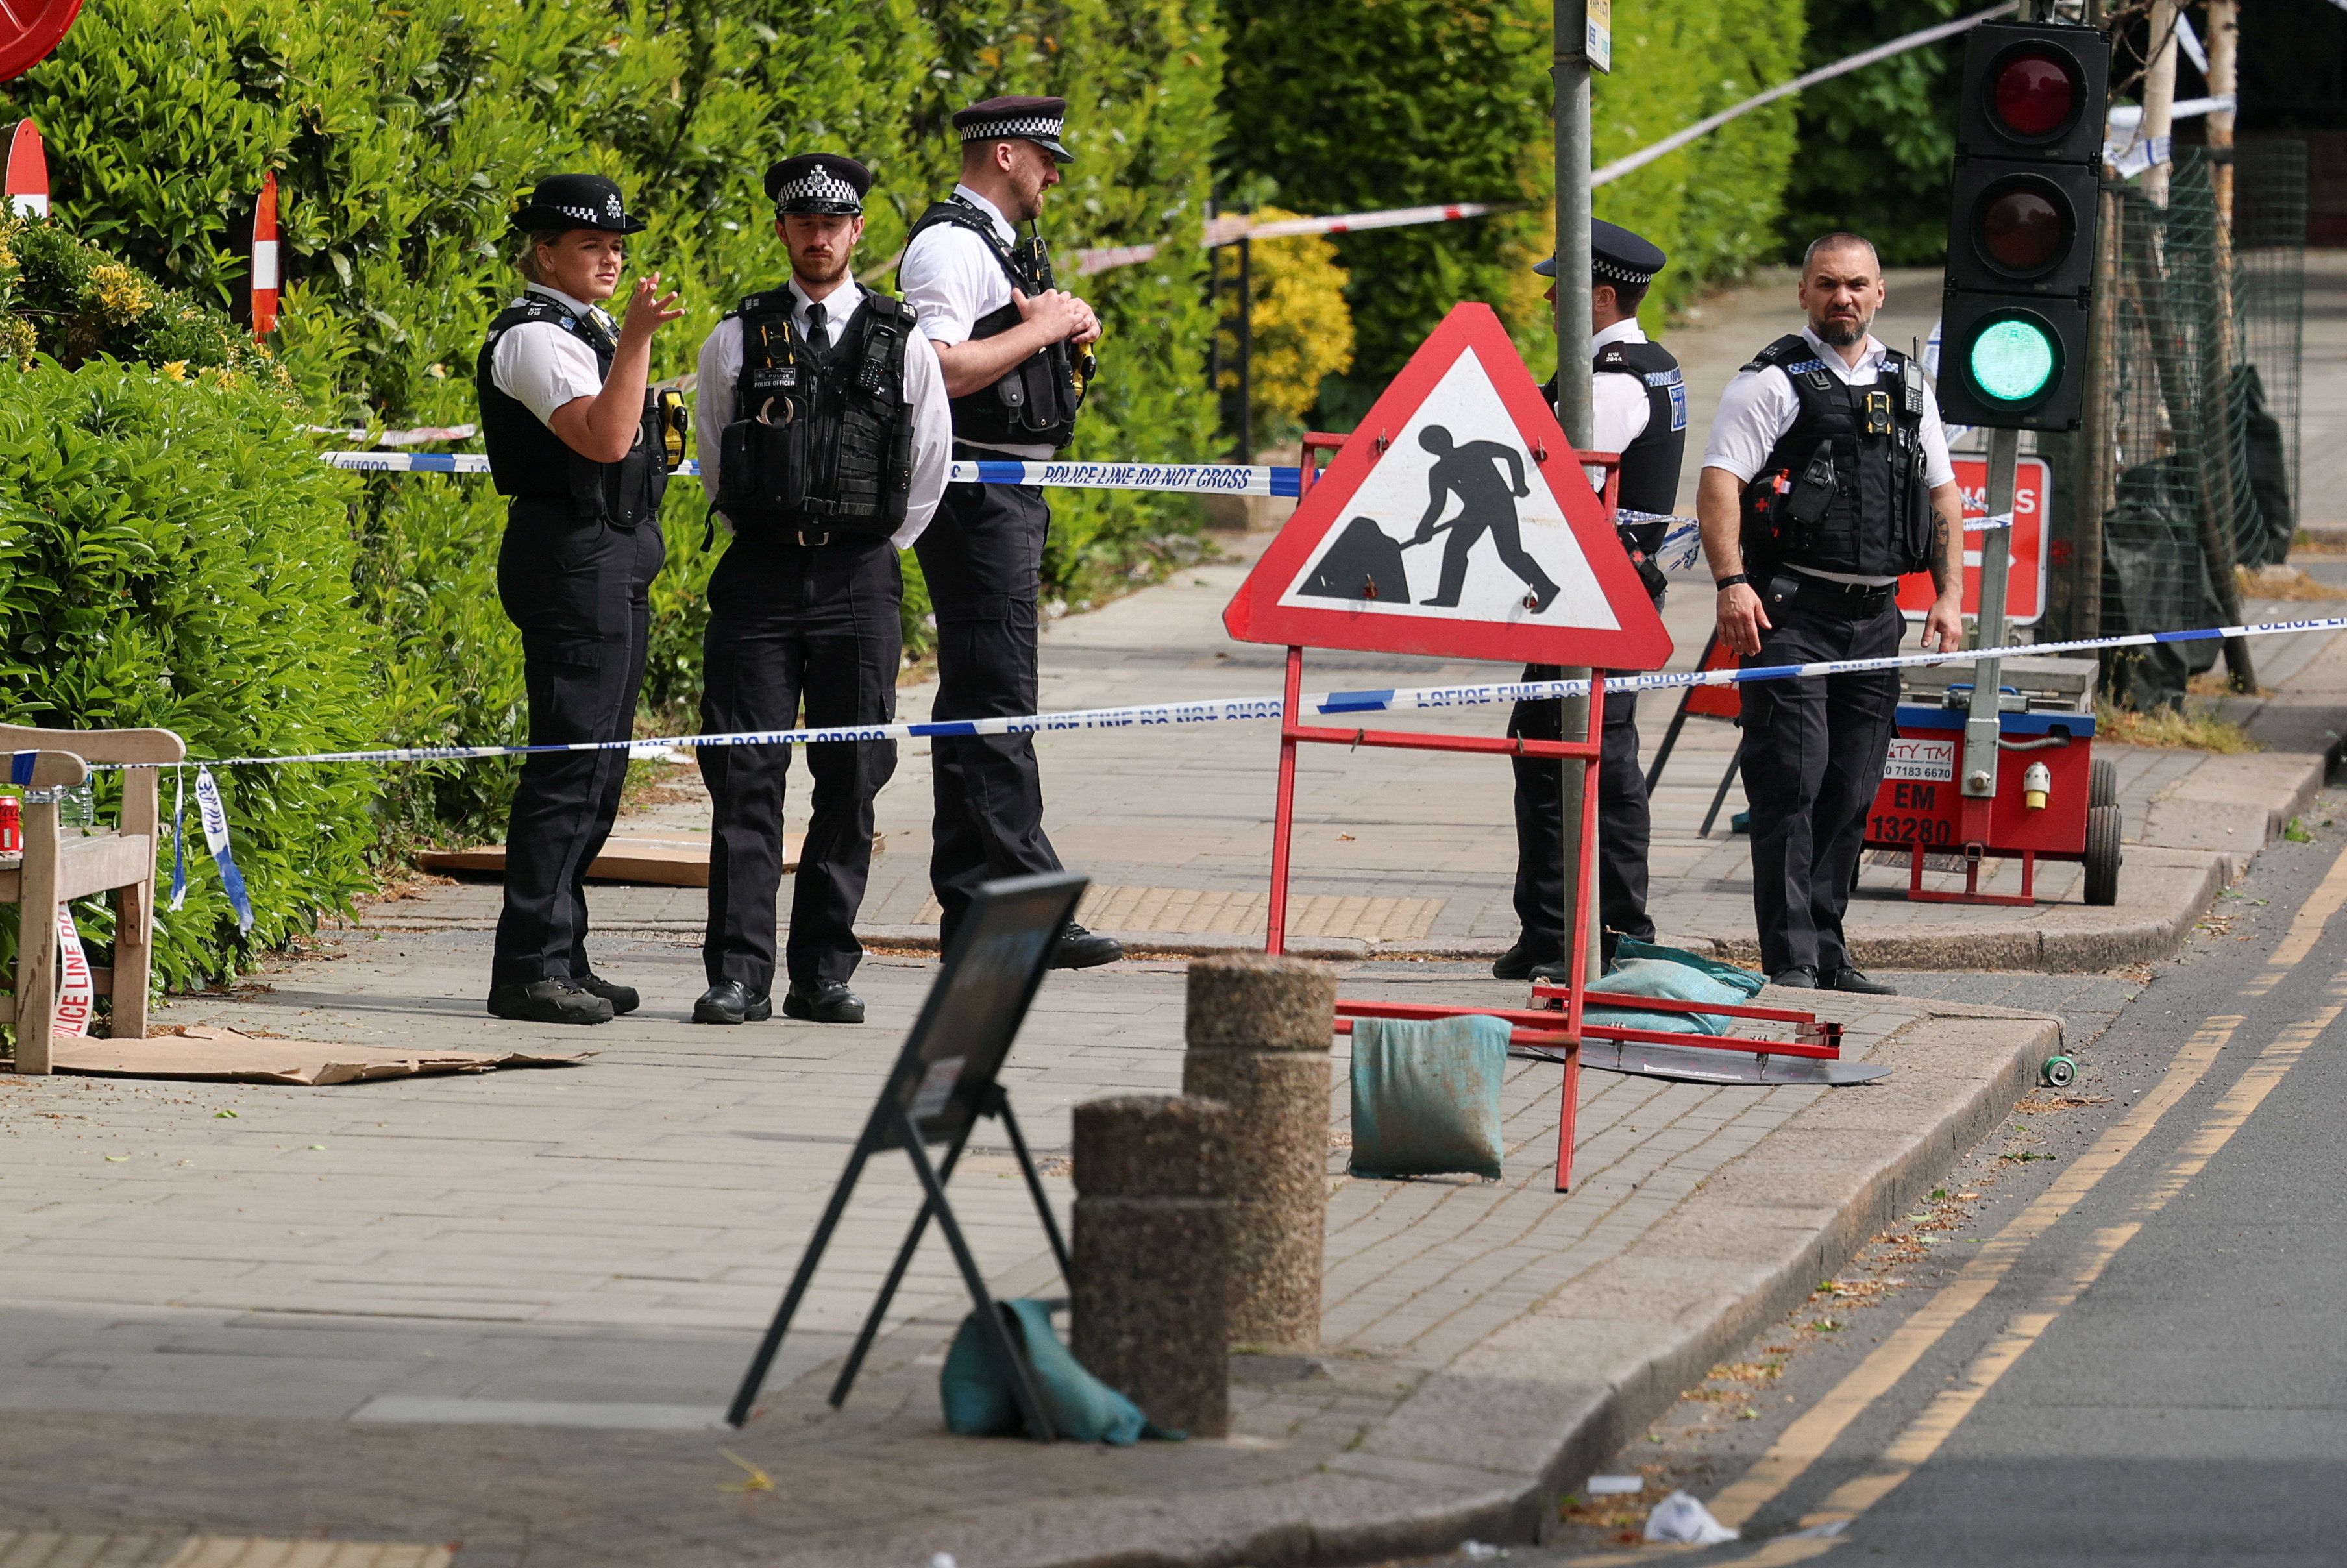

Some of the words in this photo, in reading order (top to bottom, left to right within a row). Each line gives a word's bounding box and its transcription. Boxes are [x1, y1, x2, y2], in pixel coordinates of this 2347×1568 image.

[1039, 465, 1098, 484] POLICE
[1096, 467, 1136, 485] LINE
[1135, 467, 1161, 486] DO
[1160, 468, 1198, 487] NOT
[1196, 468, 1253, 489] CROSS
[1924, 746, 1953, 761] TM
[1886, 766, 1892, 774] 0
[1895, 766, 1921, 777] 7183
[1924, 768, 1951, 778] 6670
[1895, 783, 1935, 811] EM
[1871, 815, 1951, 844] 13280
[58, 913, 76, 938] DO
[64, 944, 89, 988] LINE
[52, 995, 89, 1038] OLICE
